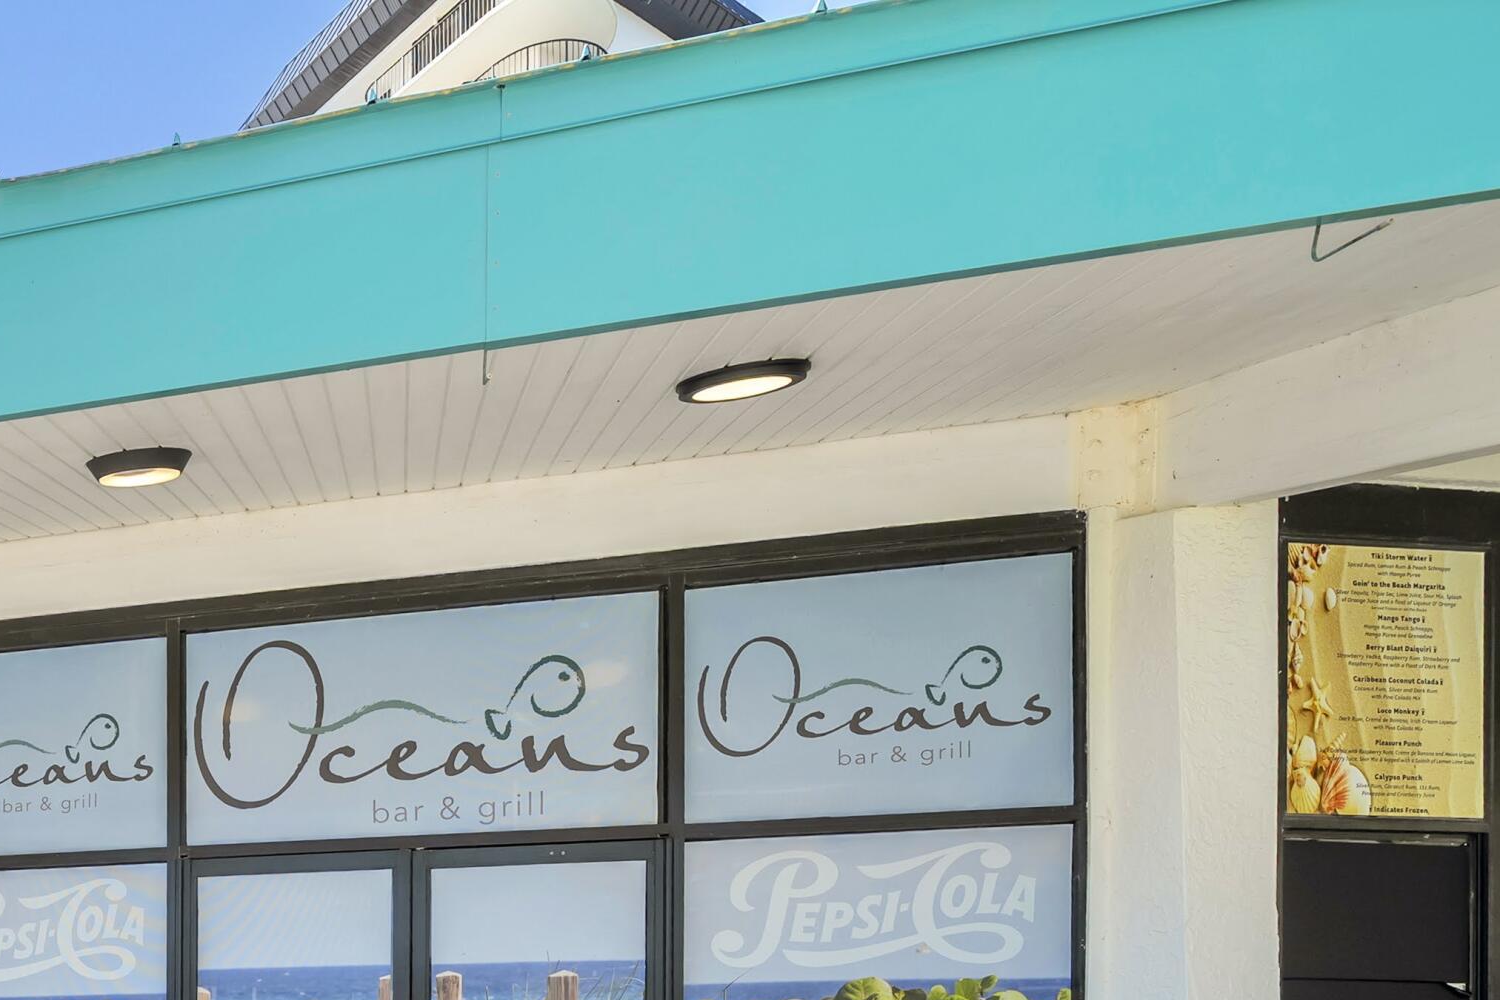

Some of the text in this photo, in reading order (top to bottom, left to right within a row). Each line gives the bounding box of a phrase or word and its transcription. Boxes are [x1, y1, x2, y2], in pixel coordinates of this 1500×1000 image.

[1371, 552, 1427, 562] Tiki Storm Water
[1413, 582, 1445, 591] Margarita
[1377, 615, 1421, 624] Mango Tango
[1366, 644, 1385, 652] Berry
[1404, 645, 1432, 654] Daiquiri
[1353, 675, 1439, 686] Caribbean Coconut Colada
[697, 636, 1051, 757] Oceans
[1393, 708, 1419, 717] Monkey
[194, 640, 650, 809] Oceans
[838, 740, 972, 766] bar & grill
[1374, 773, 1401, 781] Calypso
[2, 793, 98, 813] bar & grill
[373, 791, 545, 825] bar & grill
